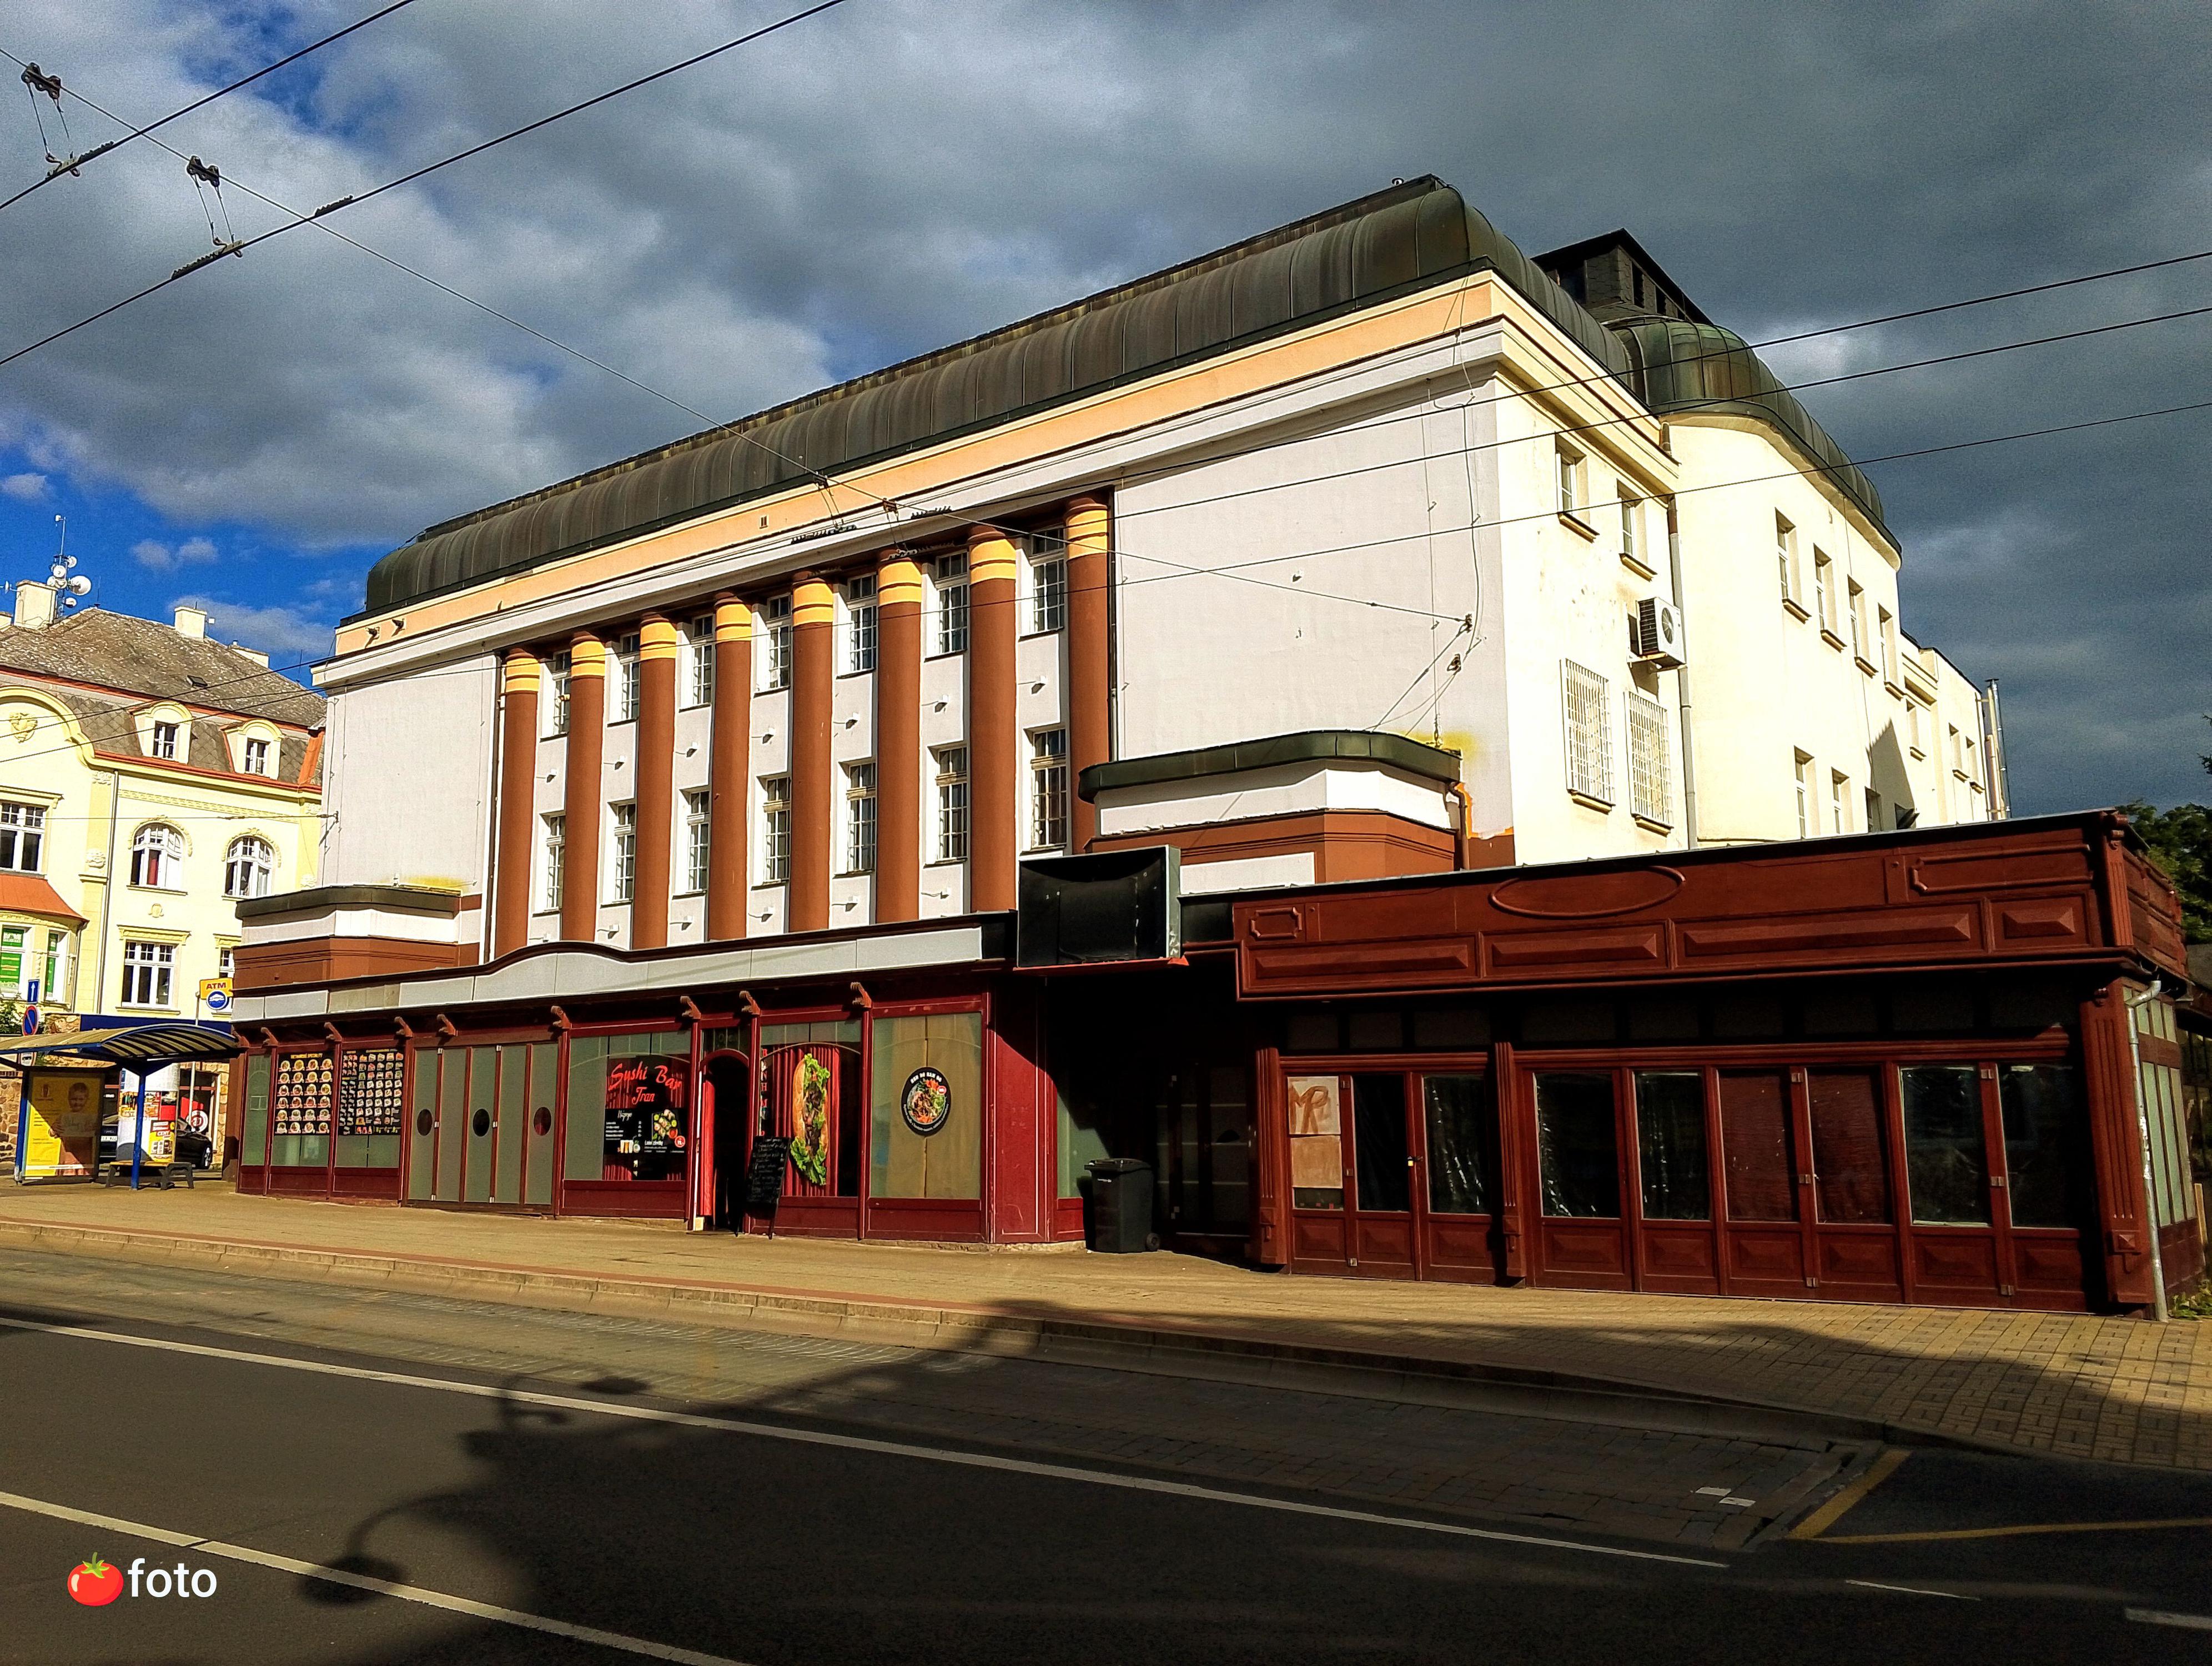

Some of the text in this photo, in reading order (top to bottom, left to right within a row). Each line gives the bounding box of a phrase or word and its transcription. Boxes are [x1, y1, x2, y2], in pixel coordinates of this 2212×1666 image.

[608, 1061, 682, 1091] Sushi Bar
[632, 1086, 655, 1105] Tran
